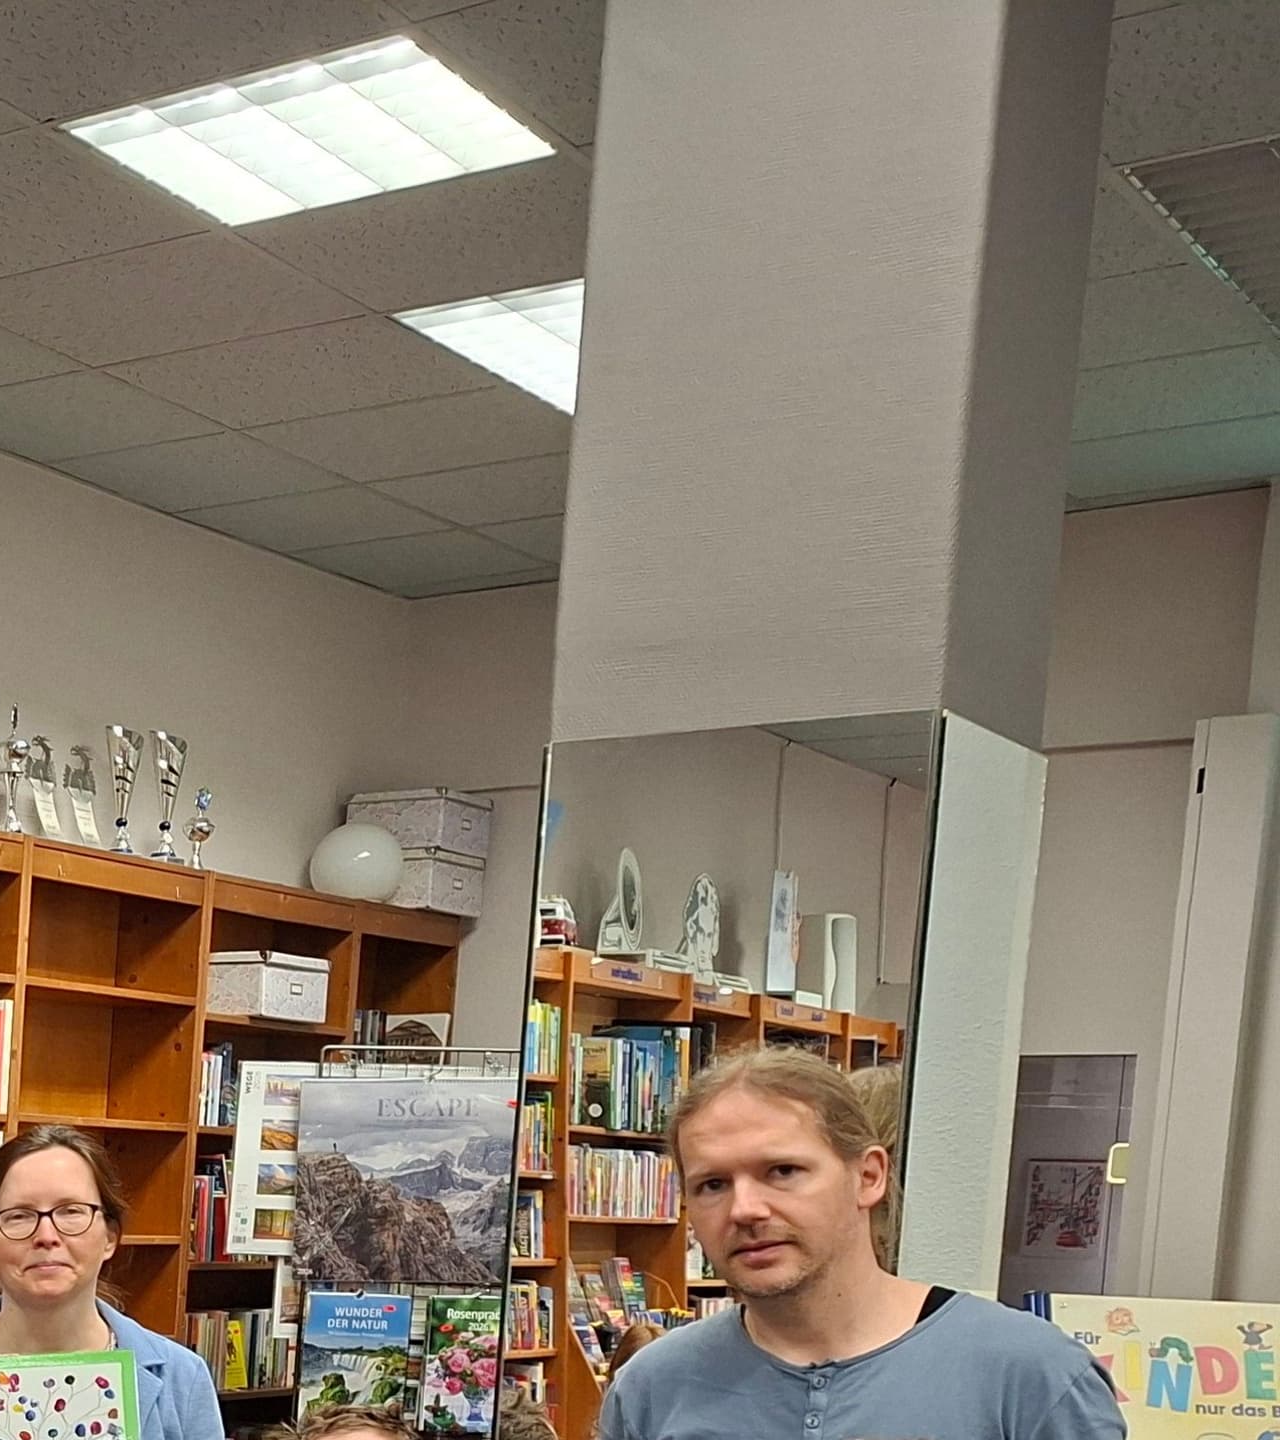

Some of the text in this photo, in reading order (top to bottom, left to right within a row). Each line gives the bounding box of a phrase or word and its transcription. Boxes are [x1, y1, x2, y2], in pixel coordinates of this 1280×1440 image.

[376, 1098, 480, 1118] ESCAPE
[334, 1306, 383, 1318] WUNDER
[327, 1318, 388, 1331] DER NATUR
[1074, 1331, 1102, 1346] Für
[1095, 1340, 1278, 1413] INDE
[1195, 1403, 1280, 1418] nur das B
